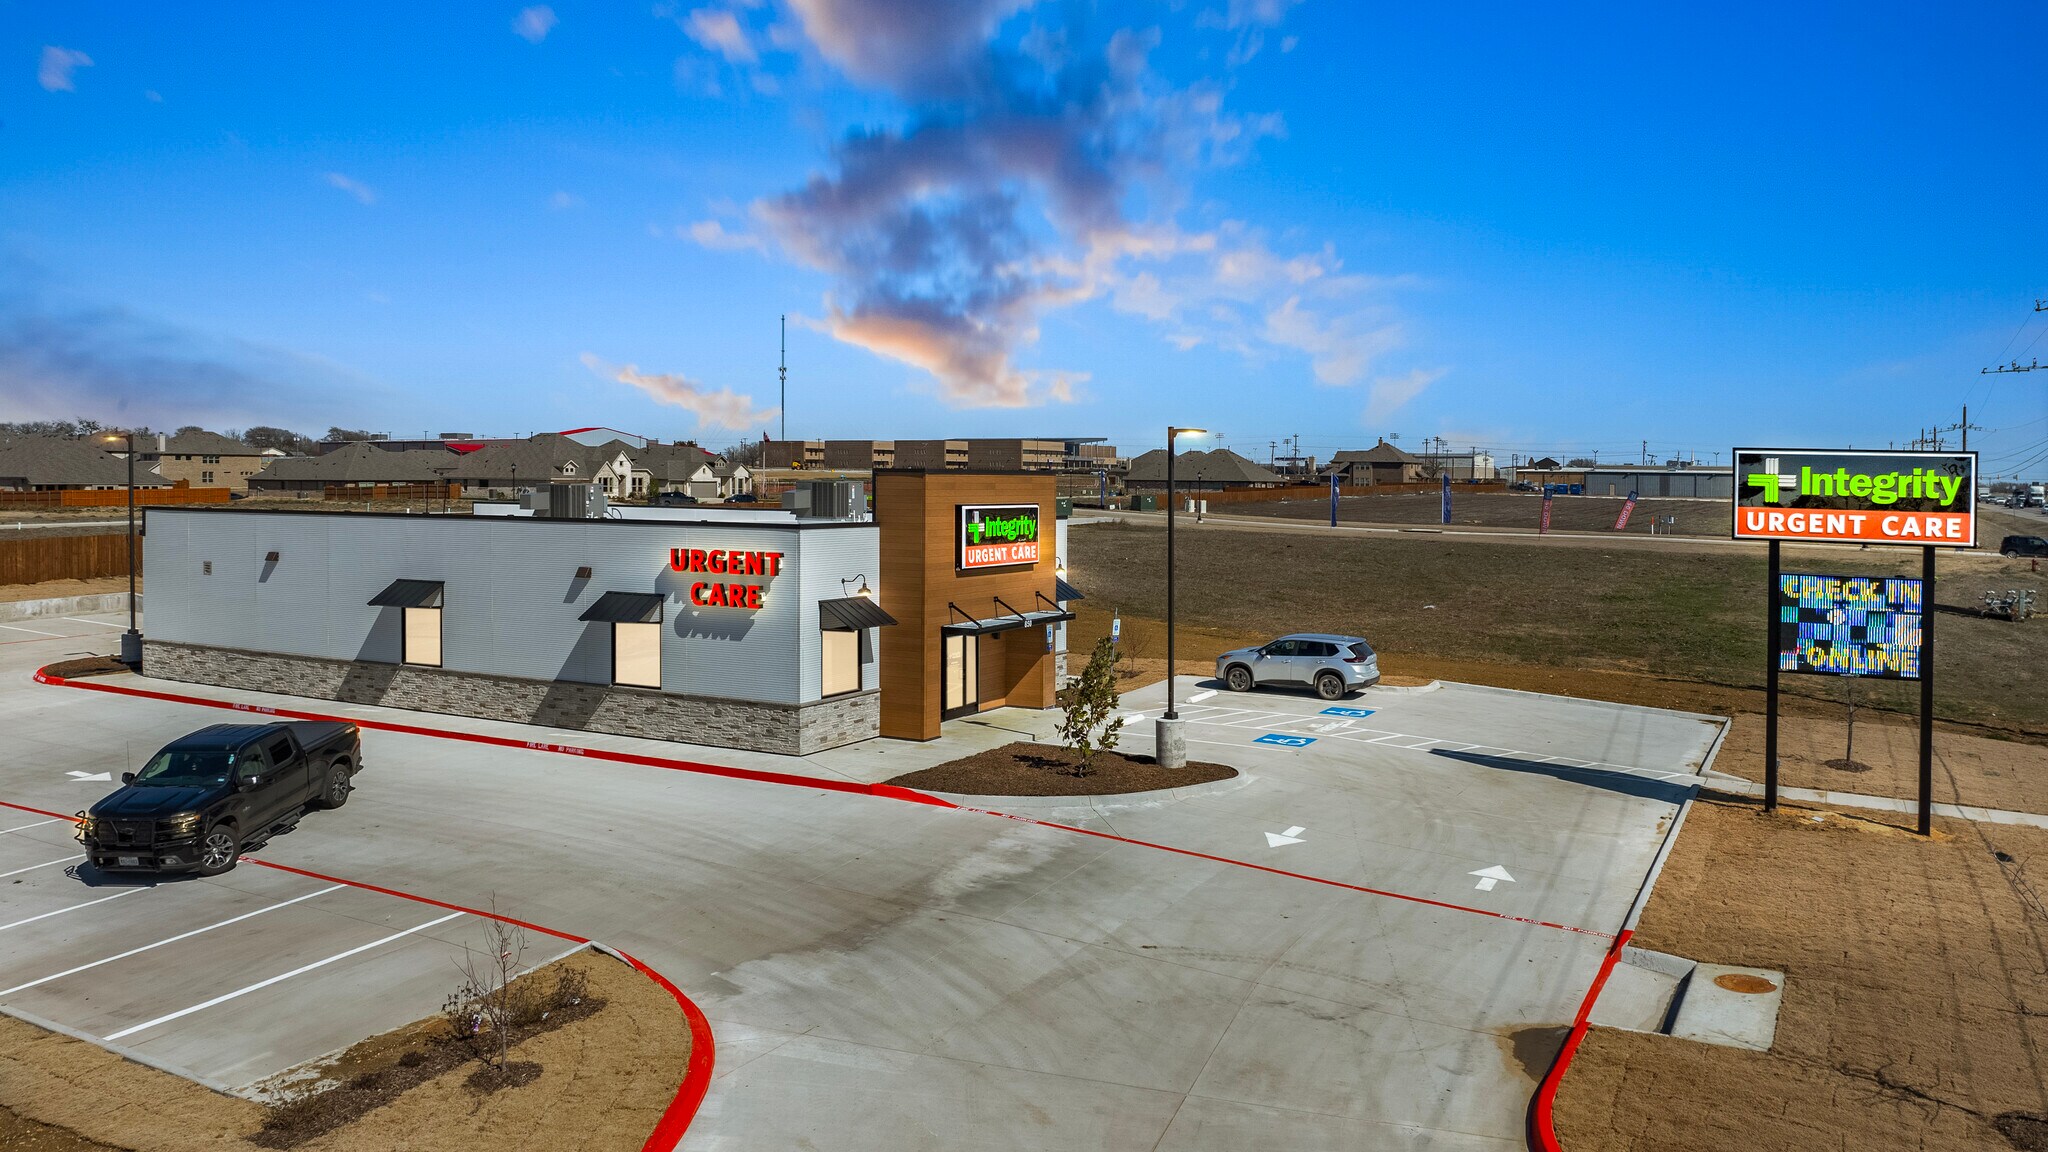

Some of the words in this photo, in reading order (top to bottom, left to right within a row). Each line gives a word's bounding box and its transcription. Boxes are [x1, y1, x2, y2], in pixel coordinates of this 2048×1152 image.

[1801, 466, 1963, 507] Integrity
[985, 515, 1036, 541] Integrity
[1746, 511, 1867, 535] URGENT
[1881, 516, 1962, 538] CARE
[669, 548, 784, 577] URGENT
[968, 547, 1007, 564] URGENT
[1011, 545, 1037, 560] CARE
[690, 581, 764, 609] CARE
[1783, 578, 1880, 602] CHECK
[1888, 583, 1920, 604] IN
[1806, 645, 1917, 672] ONLINE
[1577, 928, 1613, 939] PARKING
